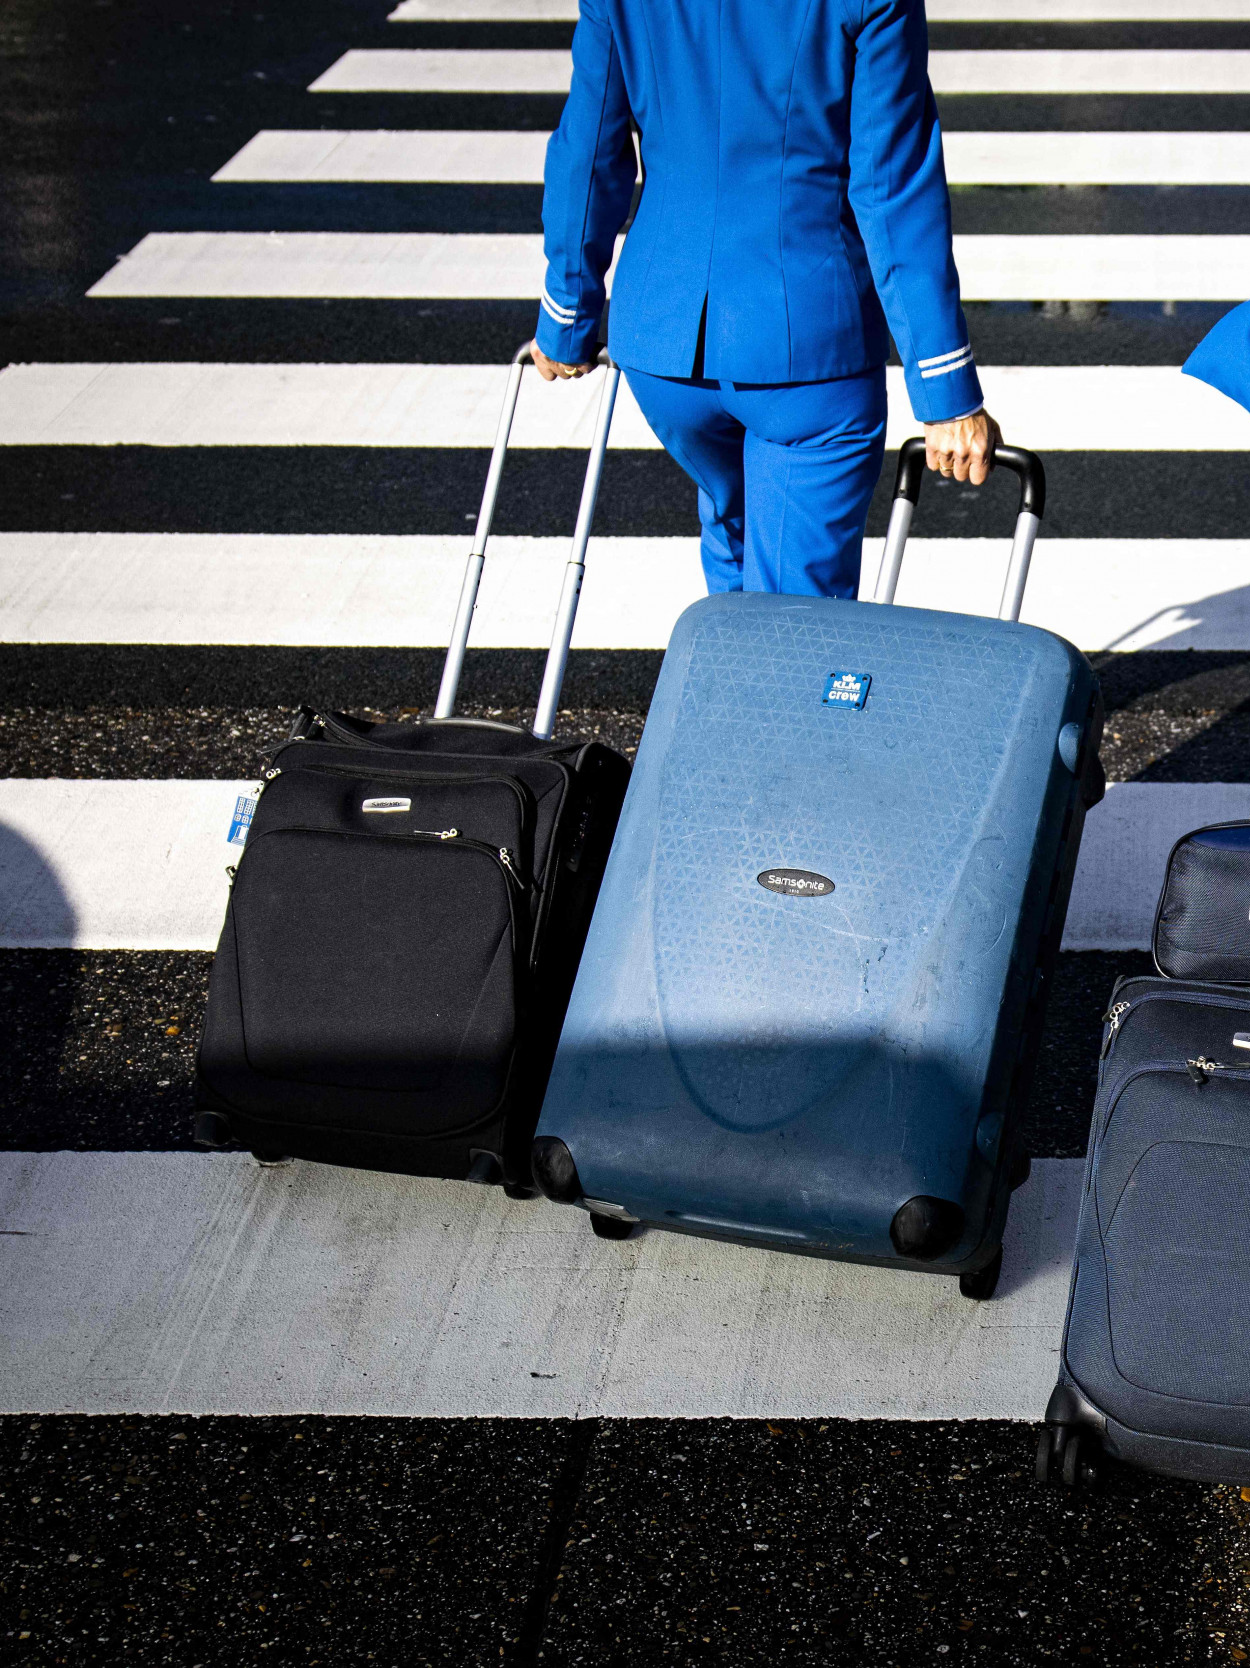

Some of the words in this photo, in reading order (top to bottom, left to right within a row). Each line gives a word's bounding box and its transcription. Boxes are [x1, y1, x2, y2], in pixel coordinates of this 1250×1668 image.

[832, 680, 861, 690] KLM
[828, 691, 860, 702] crew
[767, 874, 825, 890] Samsonite
